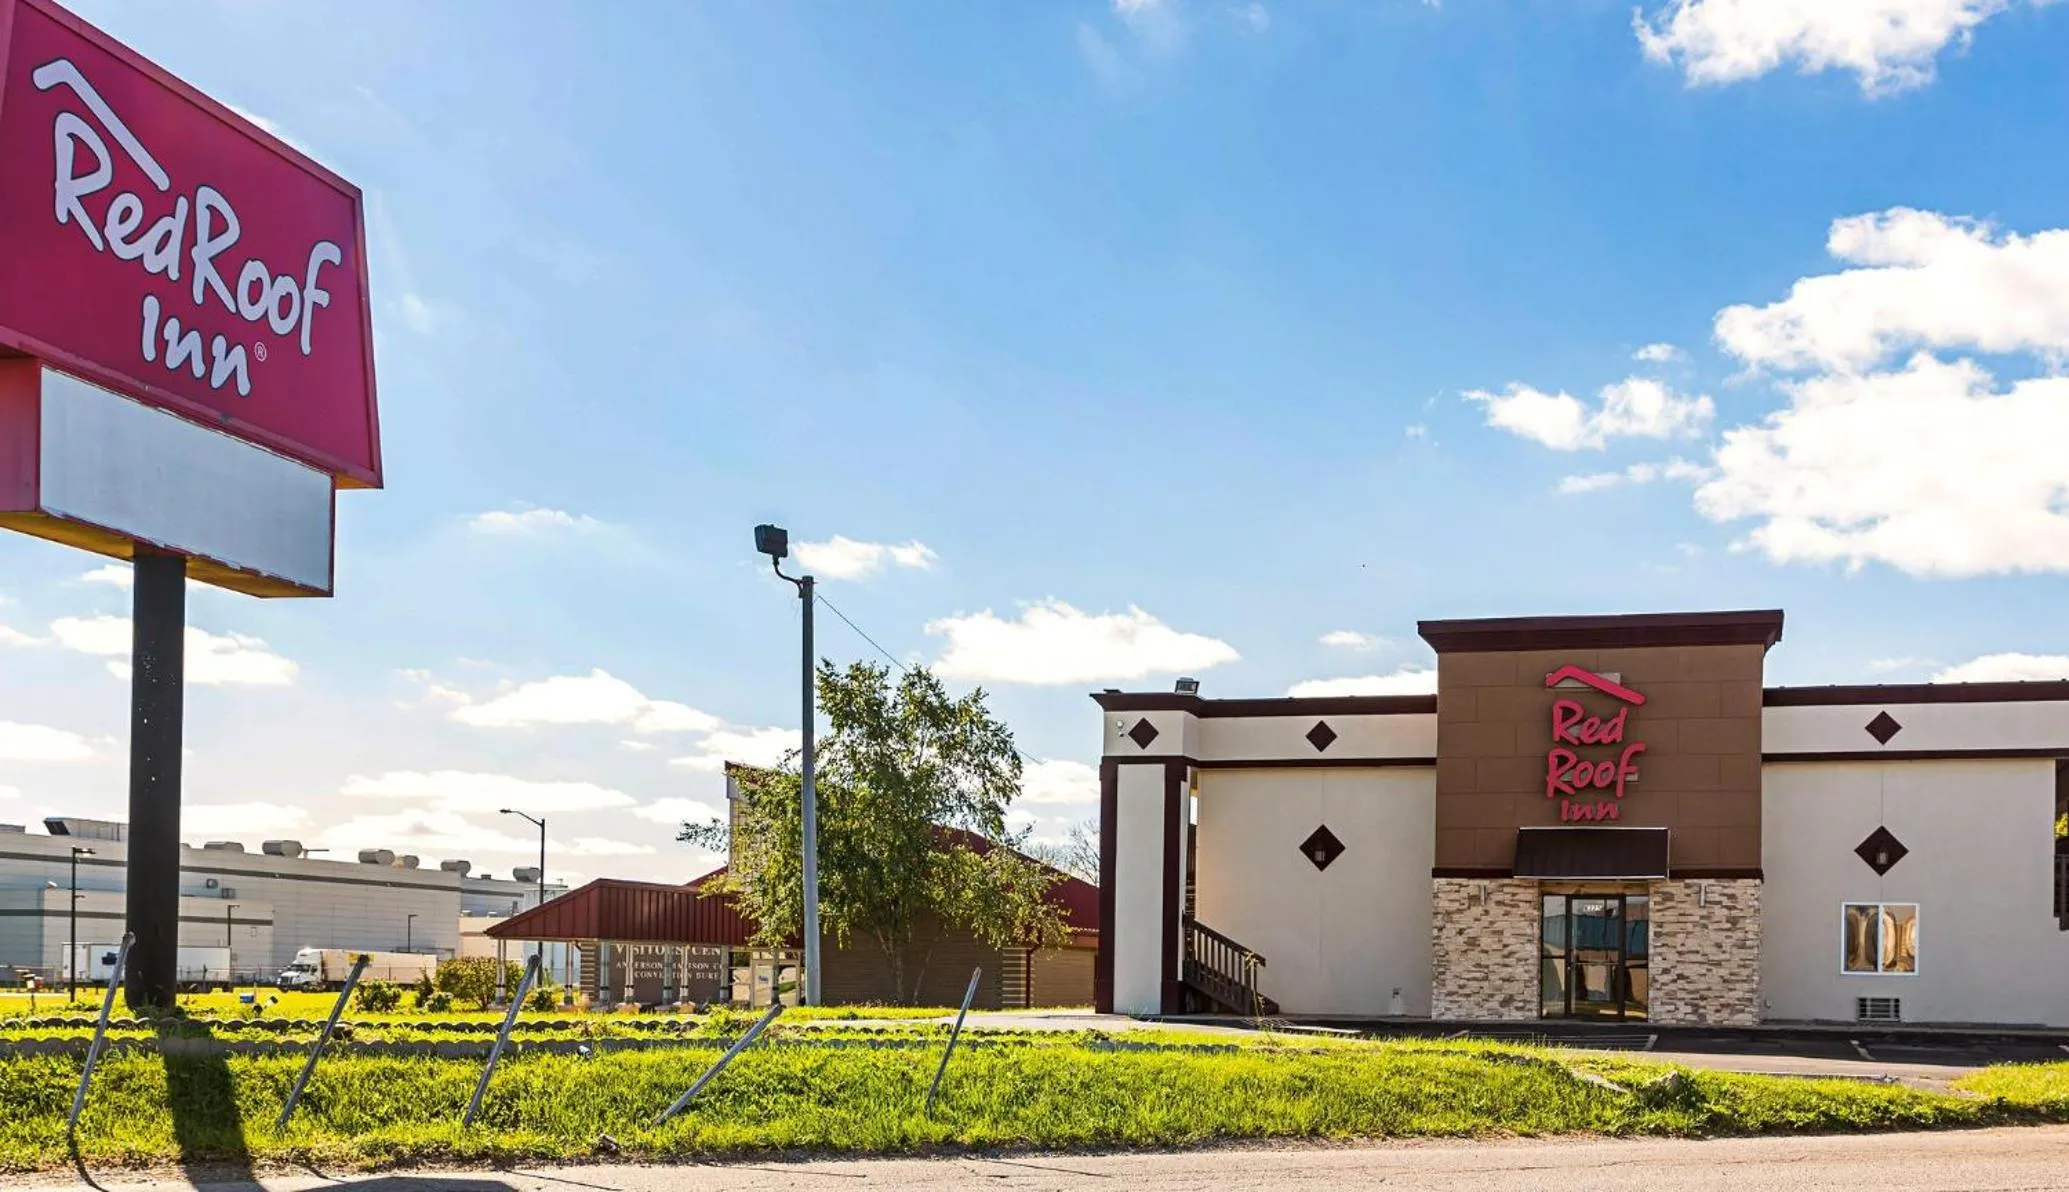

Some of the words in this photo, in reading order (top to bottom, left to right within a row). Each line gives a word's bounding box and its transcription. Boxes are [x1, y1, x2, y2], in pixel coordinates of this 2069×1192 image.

[1551, 698, 1628, 746] Red
[1545, 742, 1647, 798] Roof
[1560, 799, 1619, 822] Inn
[616, 943, 683, 956] VSITOS
[616, 961, 663, 969] ANERSON
